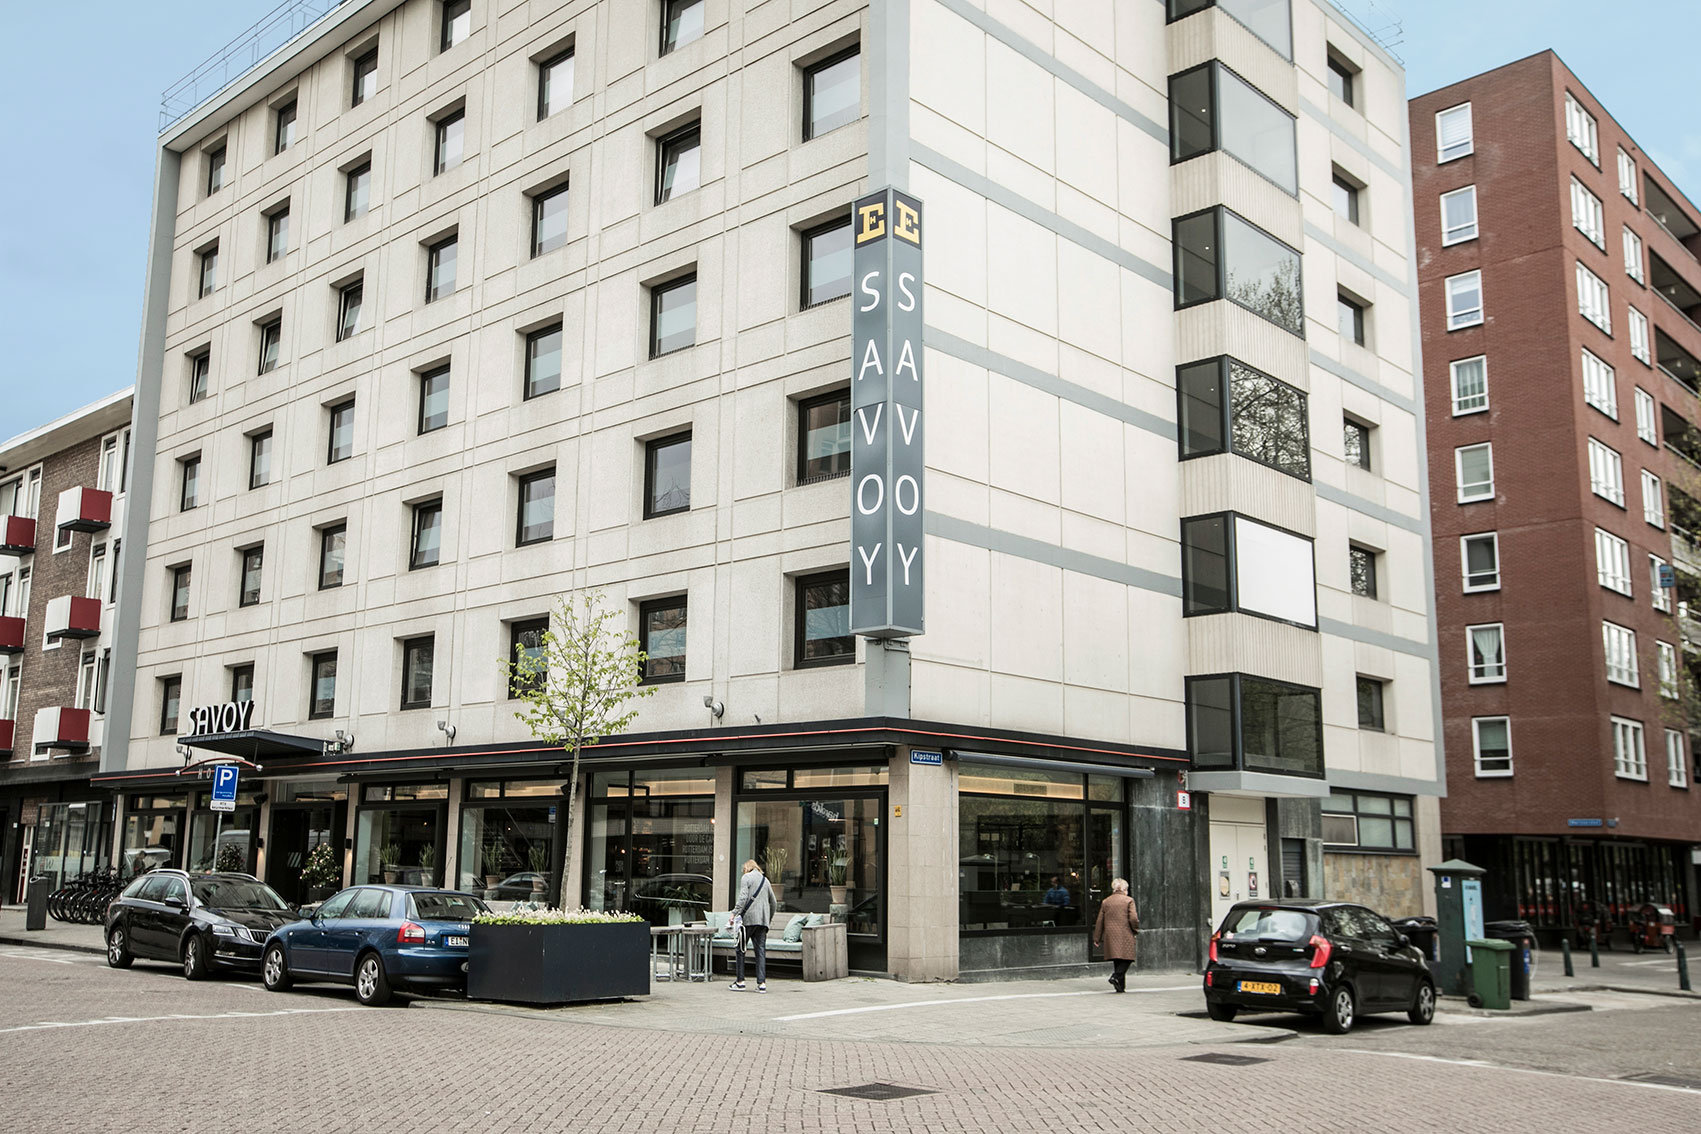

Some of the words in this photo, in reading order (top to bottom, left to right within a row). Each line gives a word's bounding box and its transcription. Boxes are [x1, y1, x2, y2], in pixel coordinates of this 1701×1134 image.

[857, 202, 885, 244] E
[894, 199, 920, 244] E
[857, 271, 884, 586] SAVOY
[895, 272, 920, 586] SAVOY
[188, 700, 253, 736] SAVOY
[219, 769, 233, 787] P
[914, 752, 940, 762] Kipstraat
